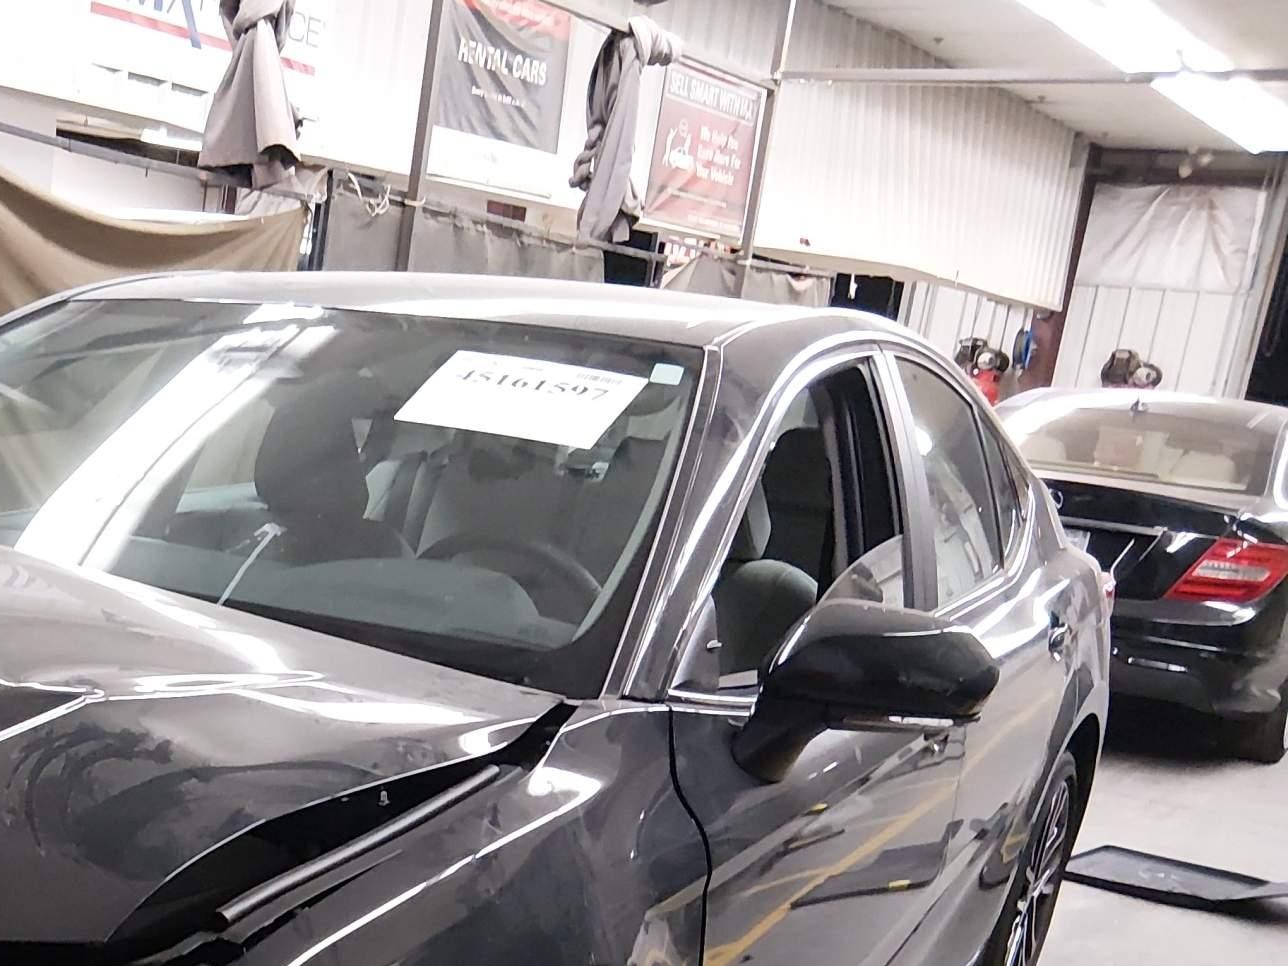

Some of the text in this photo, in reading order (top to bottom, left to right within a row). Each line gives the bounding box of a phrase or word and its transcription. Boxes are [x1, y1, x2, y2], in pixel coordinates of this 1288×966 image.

[458, 37, 547, 86] RENTAL CARS
[670, 72, 690, 97] SELL
[690, 78, 721, 108] SMART
[719, 88, 744, 117] WITH
